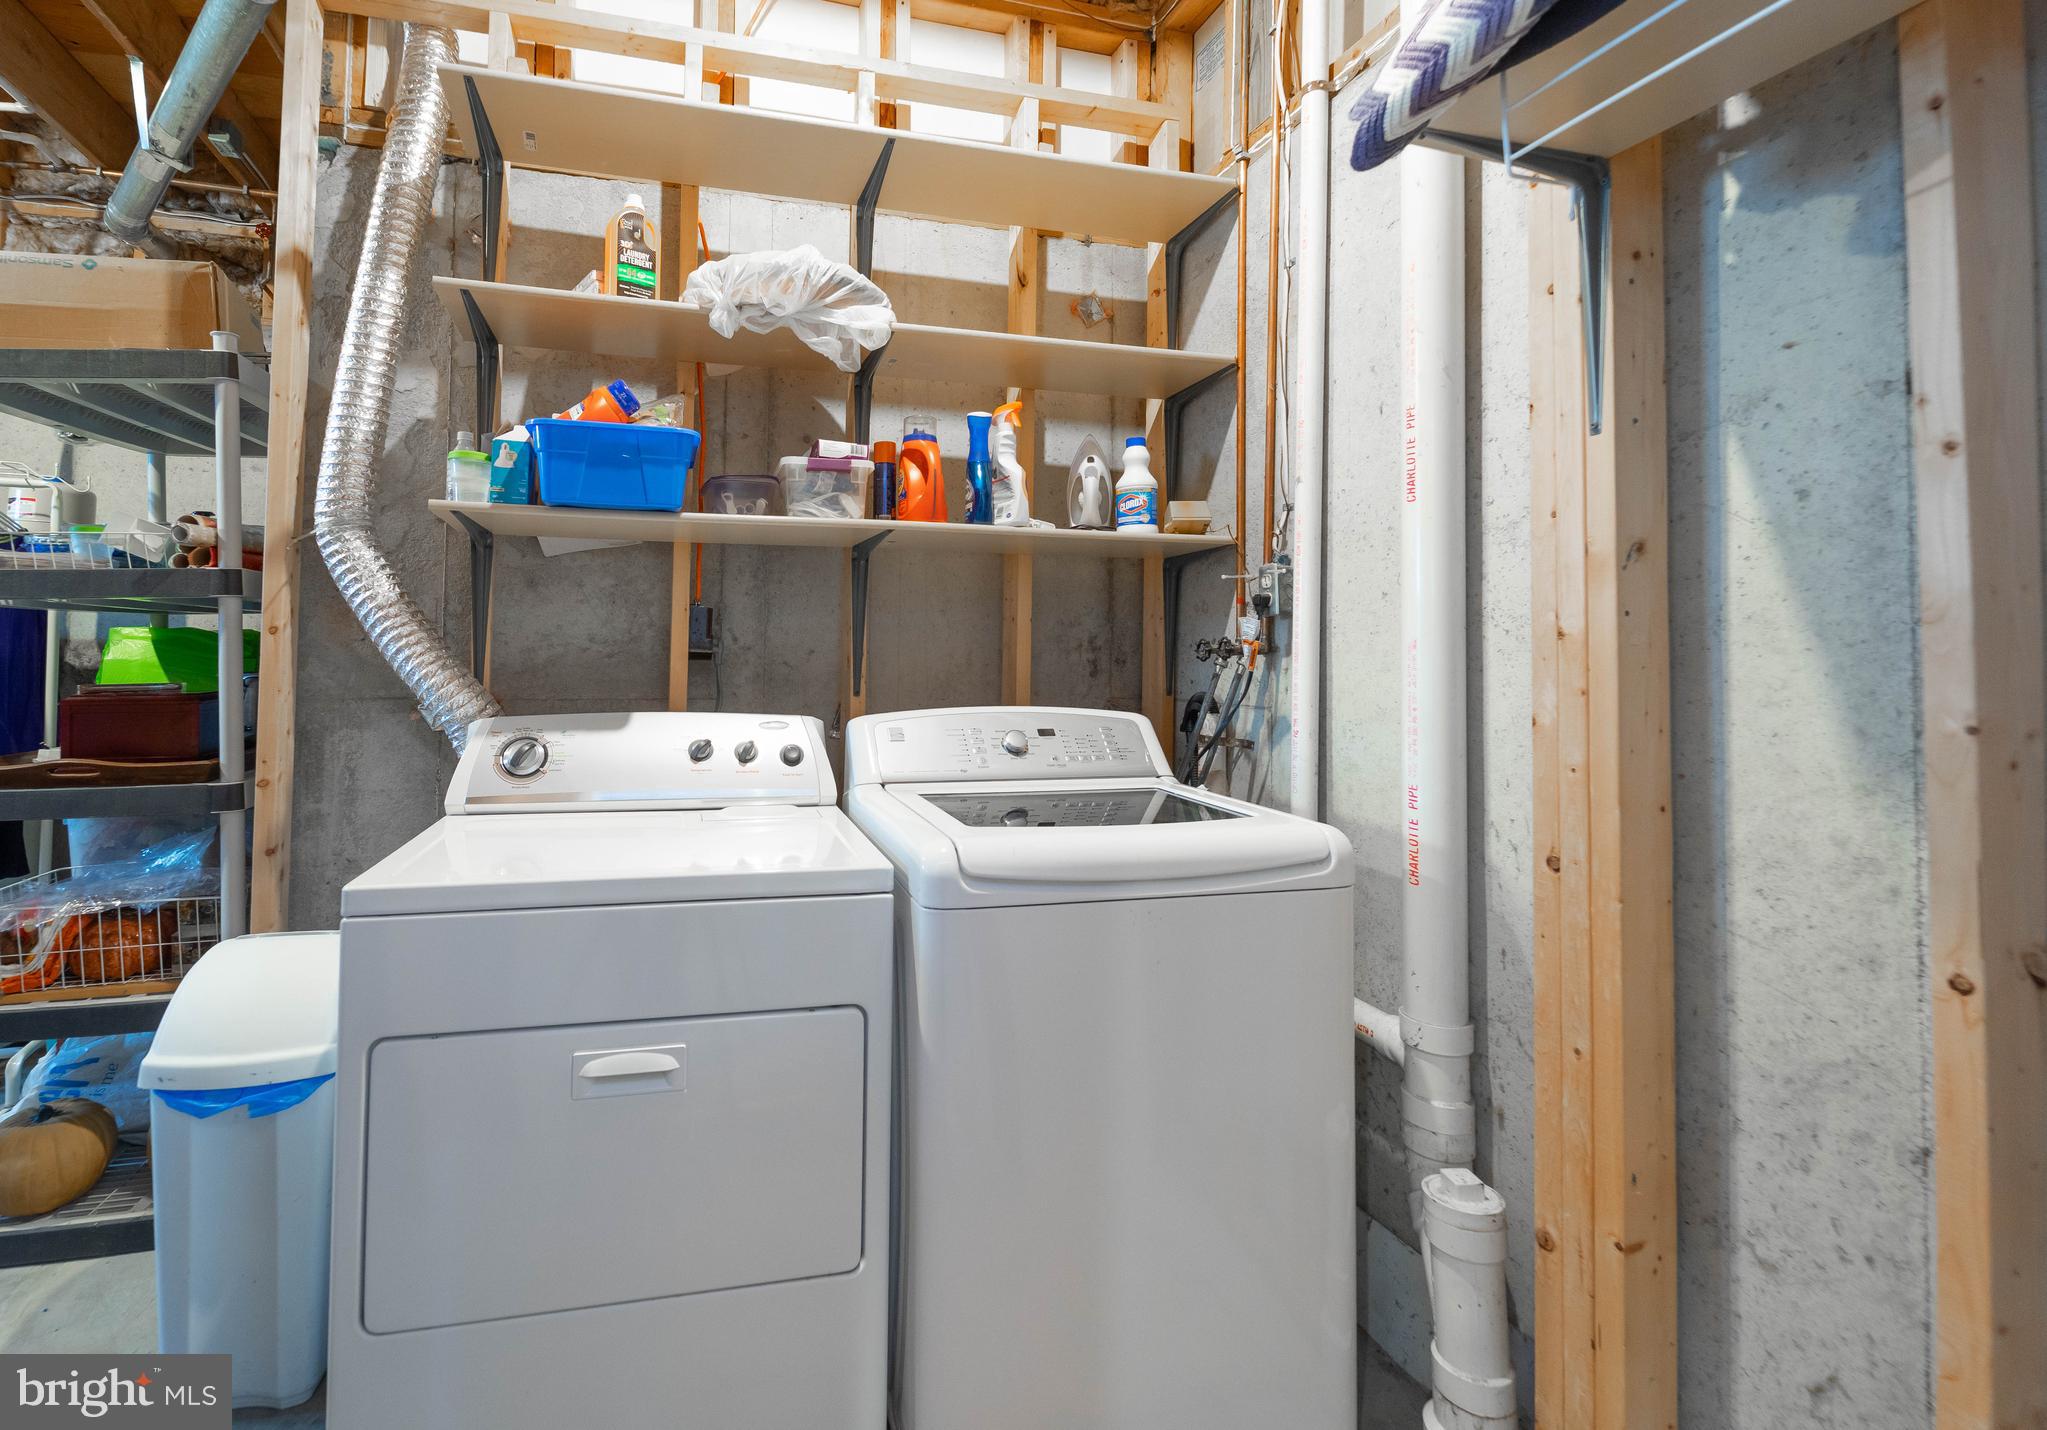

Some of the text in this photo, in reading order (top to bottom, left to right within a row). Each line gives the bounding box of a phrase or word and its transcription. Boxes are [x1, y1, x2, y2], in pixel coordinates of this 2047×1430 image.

[620, 254, 653, 270] DETERGENT
[623, 248, 650, 262] LAUNDRY
[1406, 402, 1416, 502] CHARLOTTE PIPE
[1120, 496, 1145, 512] CLOROX
[1408, 784, 1418, 810] PIPE
[1408, 818, 1420, 886] CHARLOTTE
[102, 1062, 119, 1085] me
